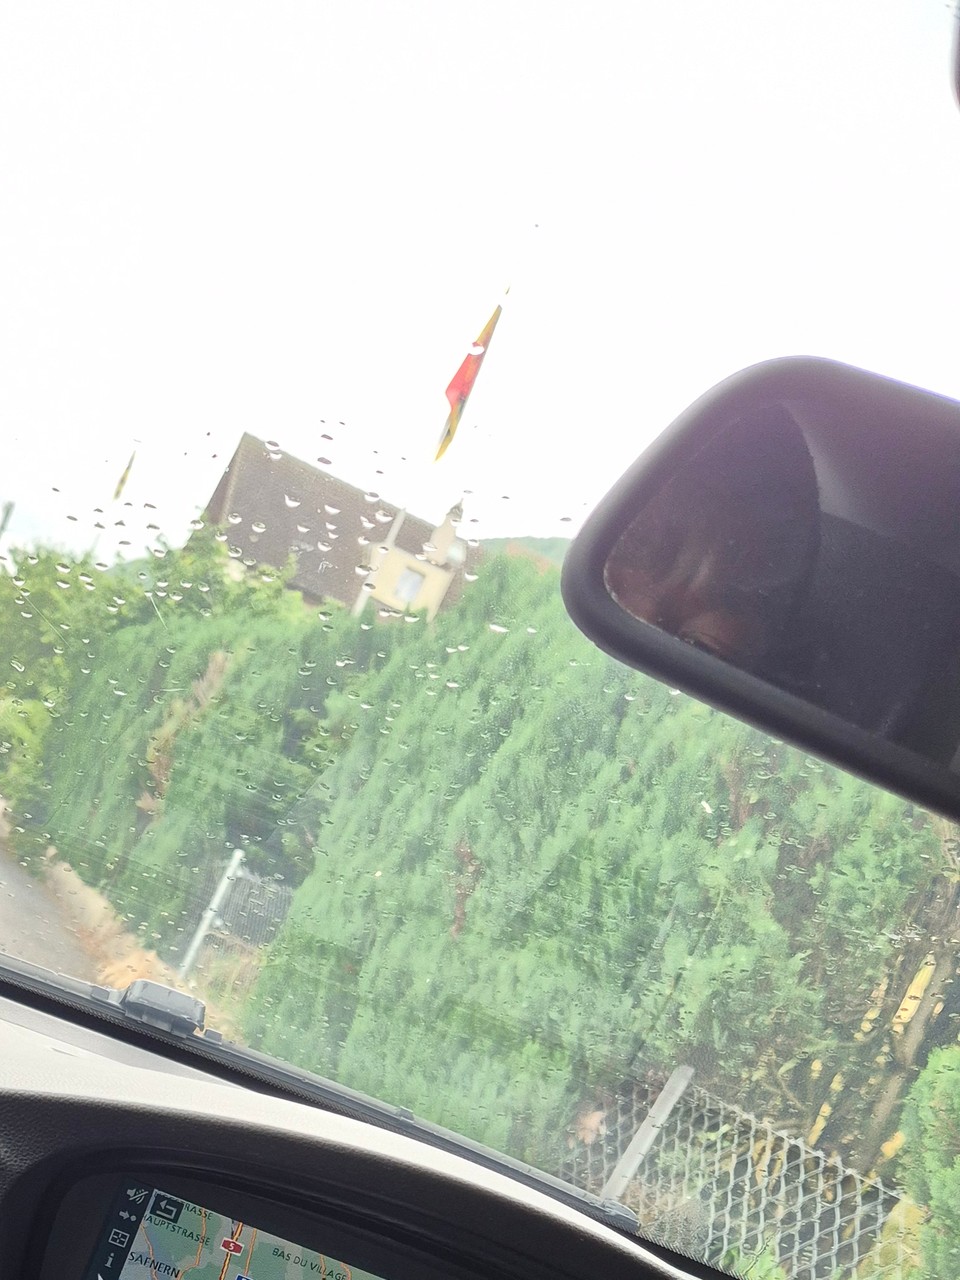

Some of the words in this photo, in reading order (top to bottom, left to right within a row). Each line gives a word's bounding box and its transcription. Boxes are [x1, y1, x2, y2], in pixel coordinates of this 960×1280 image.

[228, 1242, 236, 1251] 5
[127, 1251, 181, 1279] SAFNERN
[271, 1247, 291, 1262] BAS
[293, 1255, 308, 1268] DU
